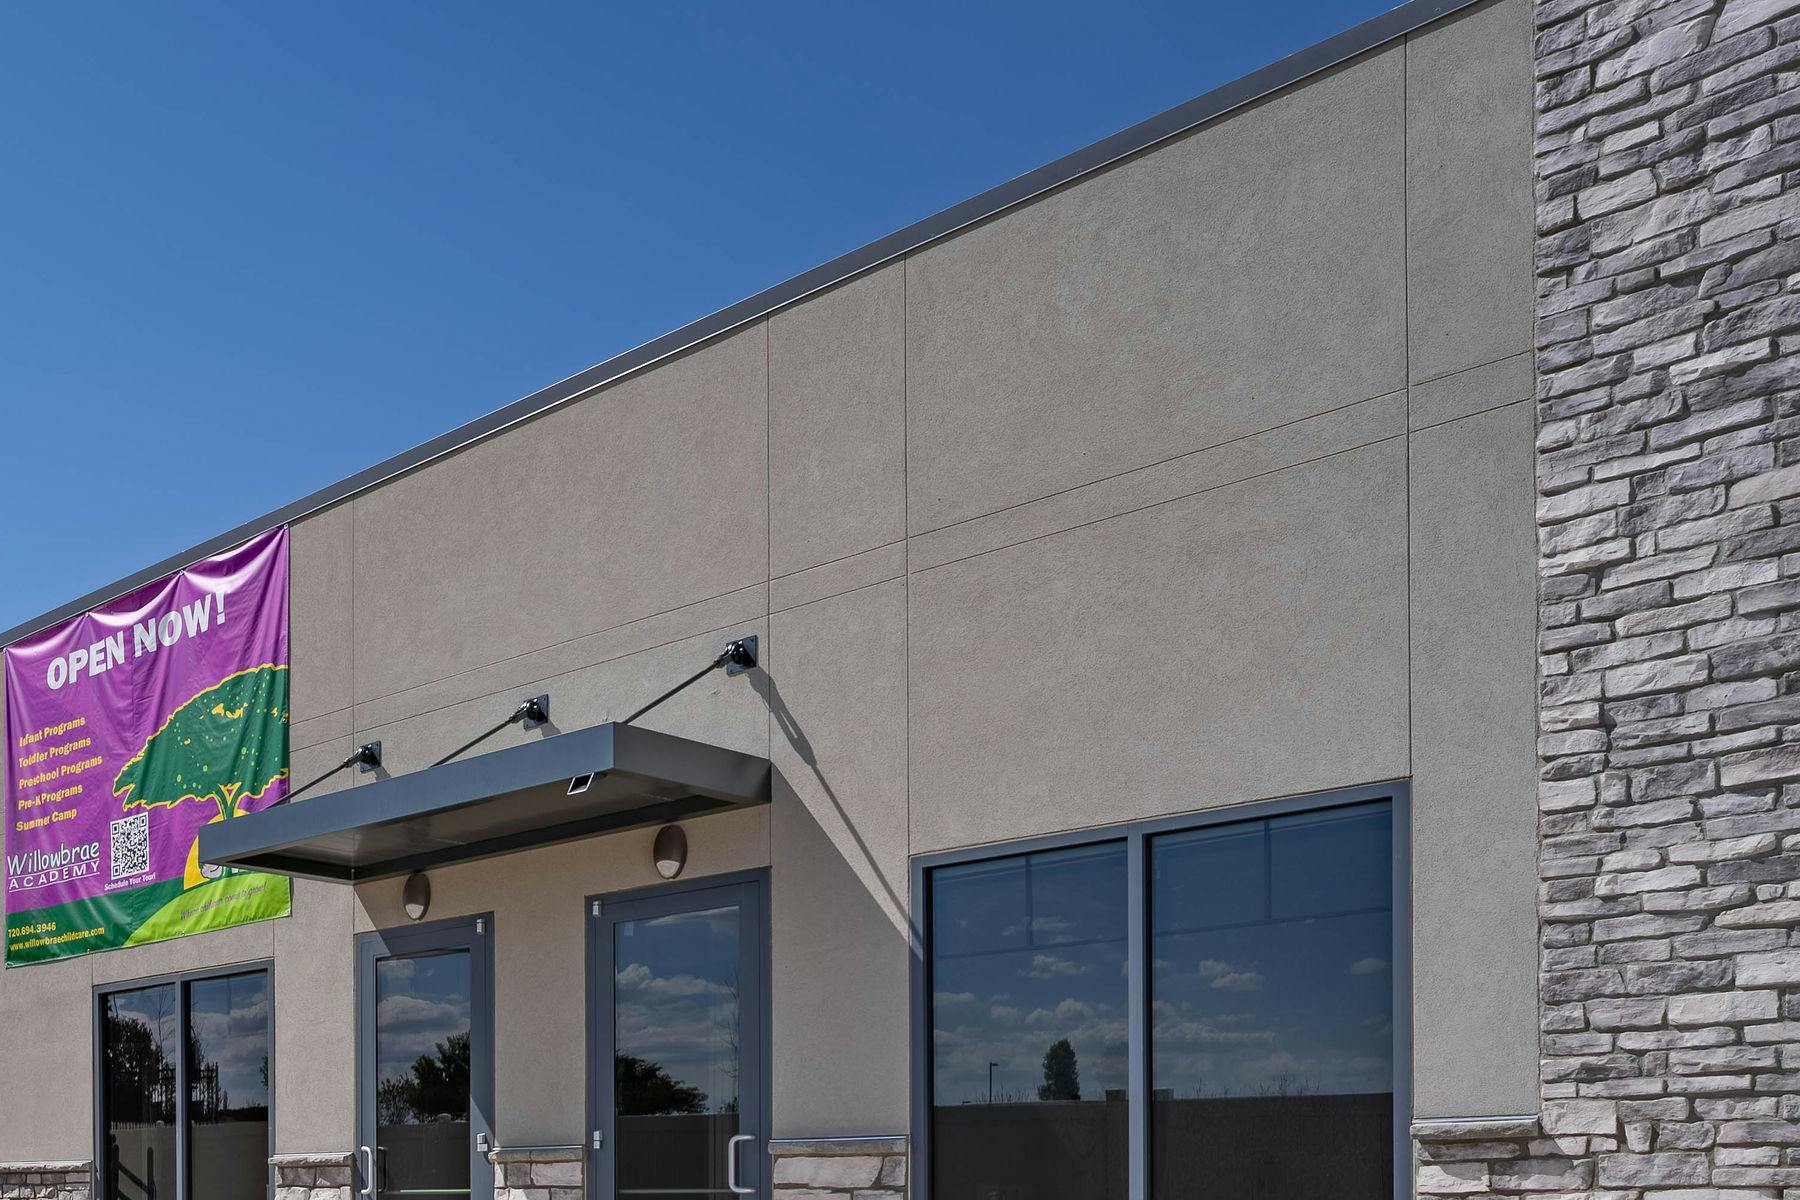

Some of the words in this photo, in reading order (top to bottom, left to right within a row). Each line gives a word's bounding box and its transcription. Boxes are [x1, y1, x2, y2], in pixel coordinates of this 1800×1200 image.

[46, 631, 125, 689] OPEN
[133, 590, 225, 657] NOW!
[18, 730, 43, 747] Infant
[44, 716, 86, 738] Programs
[18, 752, 47, 768] Toddler
[49, 736, 92, 757] Programs
[18, 768, 59, 789] Preschool
[60, 755, 103, 776] Programs
[18, 794, 41, 810] Pre-K
[41, 784, 82, 804] Programs
[16, 815, 50, 832] Summer
[51, 808, 78, 824] Camp
[7, 842, 100, 876] Willowbrae
[8, 860, 100, 890] ACADEMY
[104, 880, 129, 891] Schedule
[129, 876, 142, 886] Your
[142, 872, 156, 882] Tour!
[7, 922, 57, 938] 720.694.3946
[8, 928, 104, 951] www.willowbraechildcare.com
